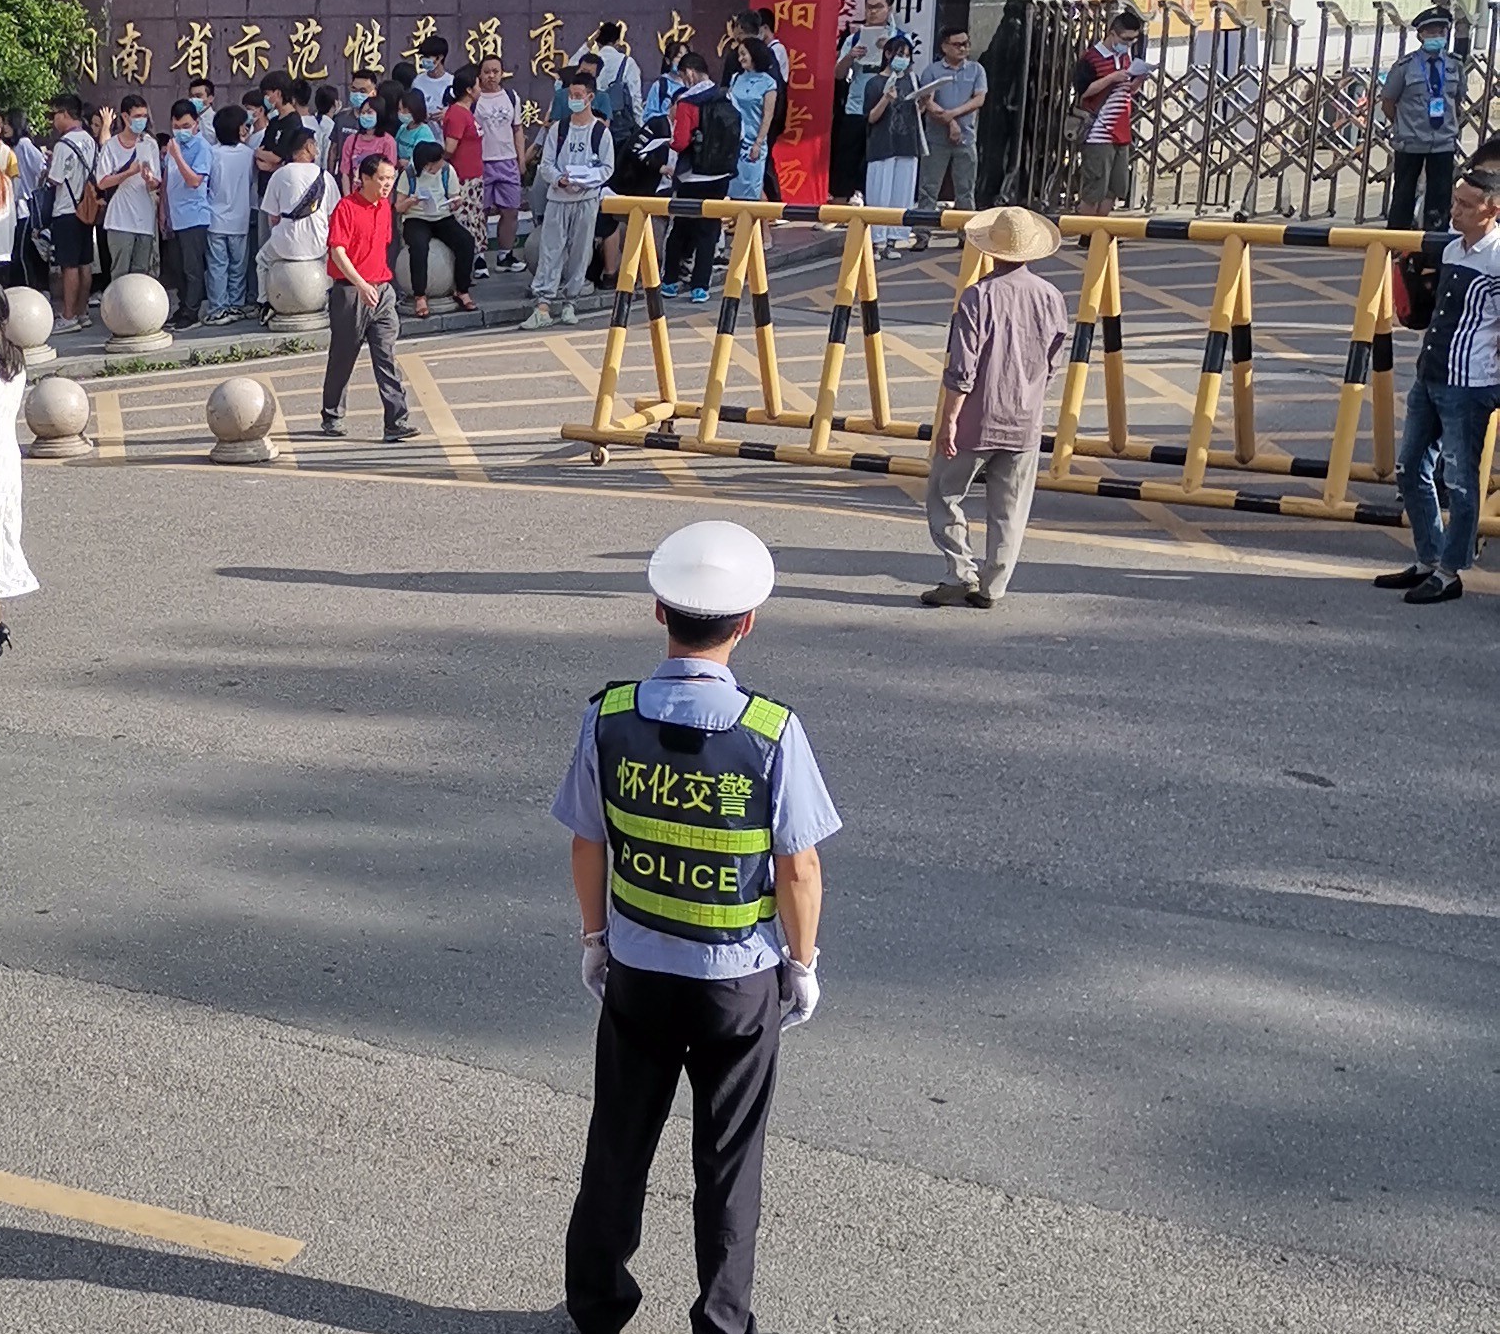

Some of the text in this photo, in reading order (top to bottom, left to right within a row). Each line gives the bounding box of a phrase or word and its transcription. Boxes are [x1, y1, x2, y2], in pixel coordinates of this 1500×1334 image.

[616, 756, 753, 818] 怀化交警
[621, 841, 739, 894] POLICE
